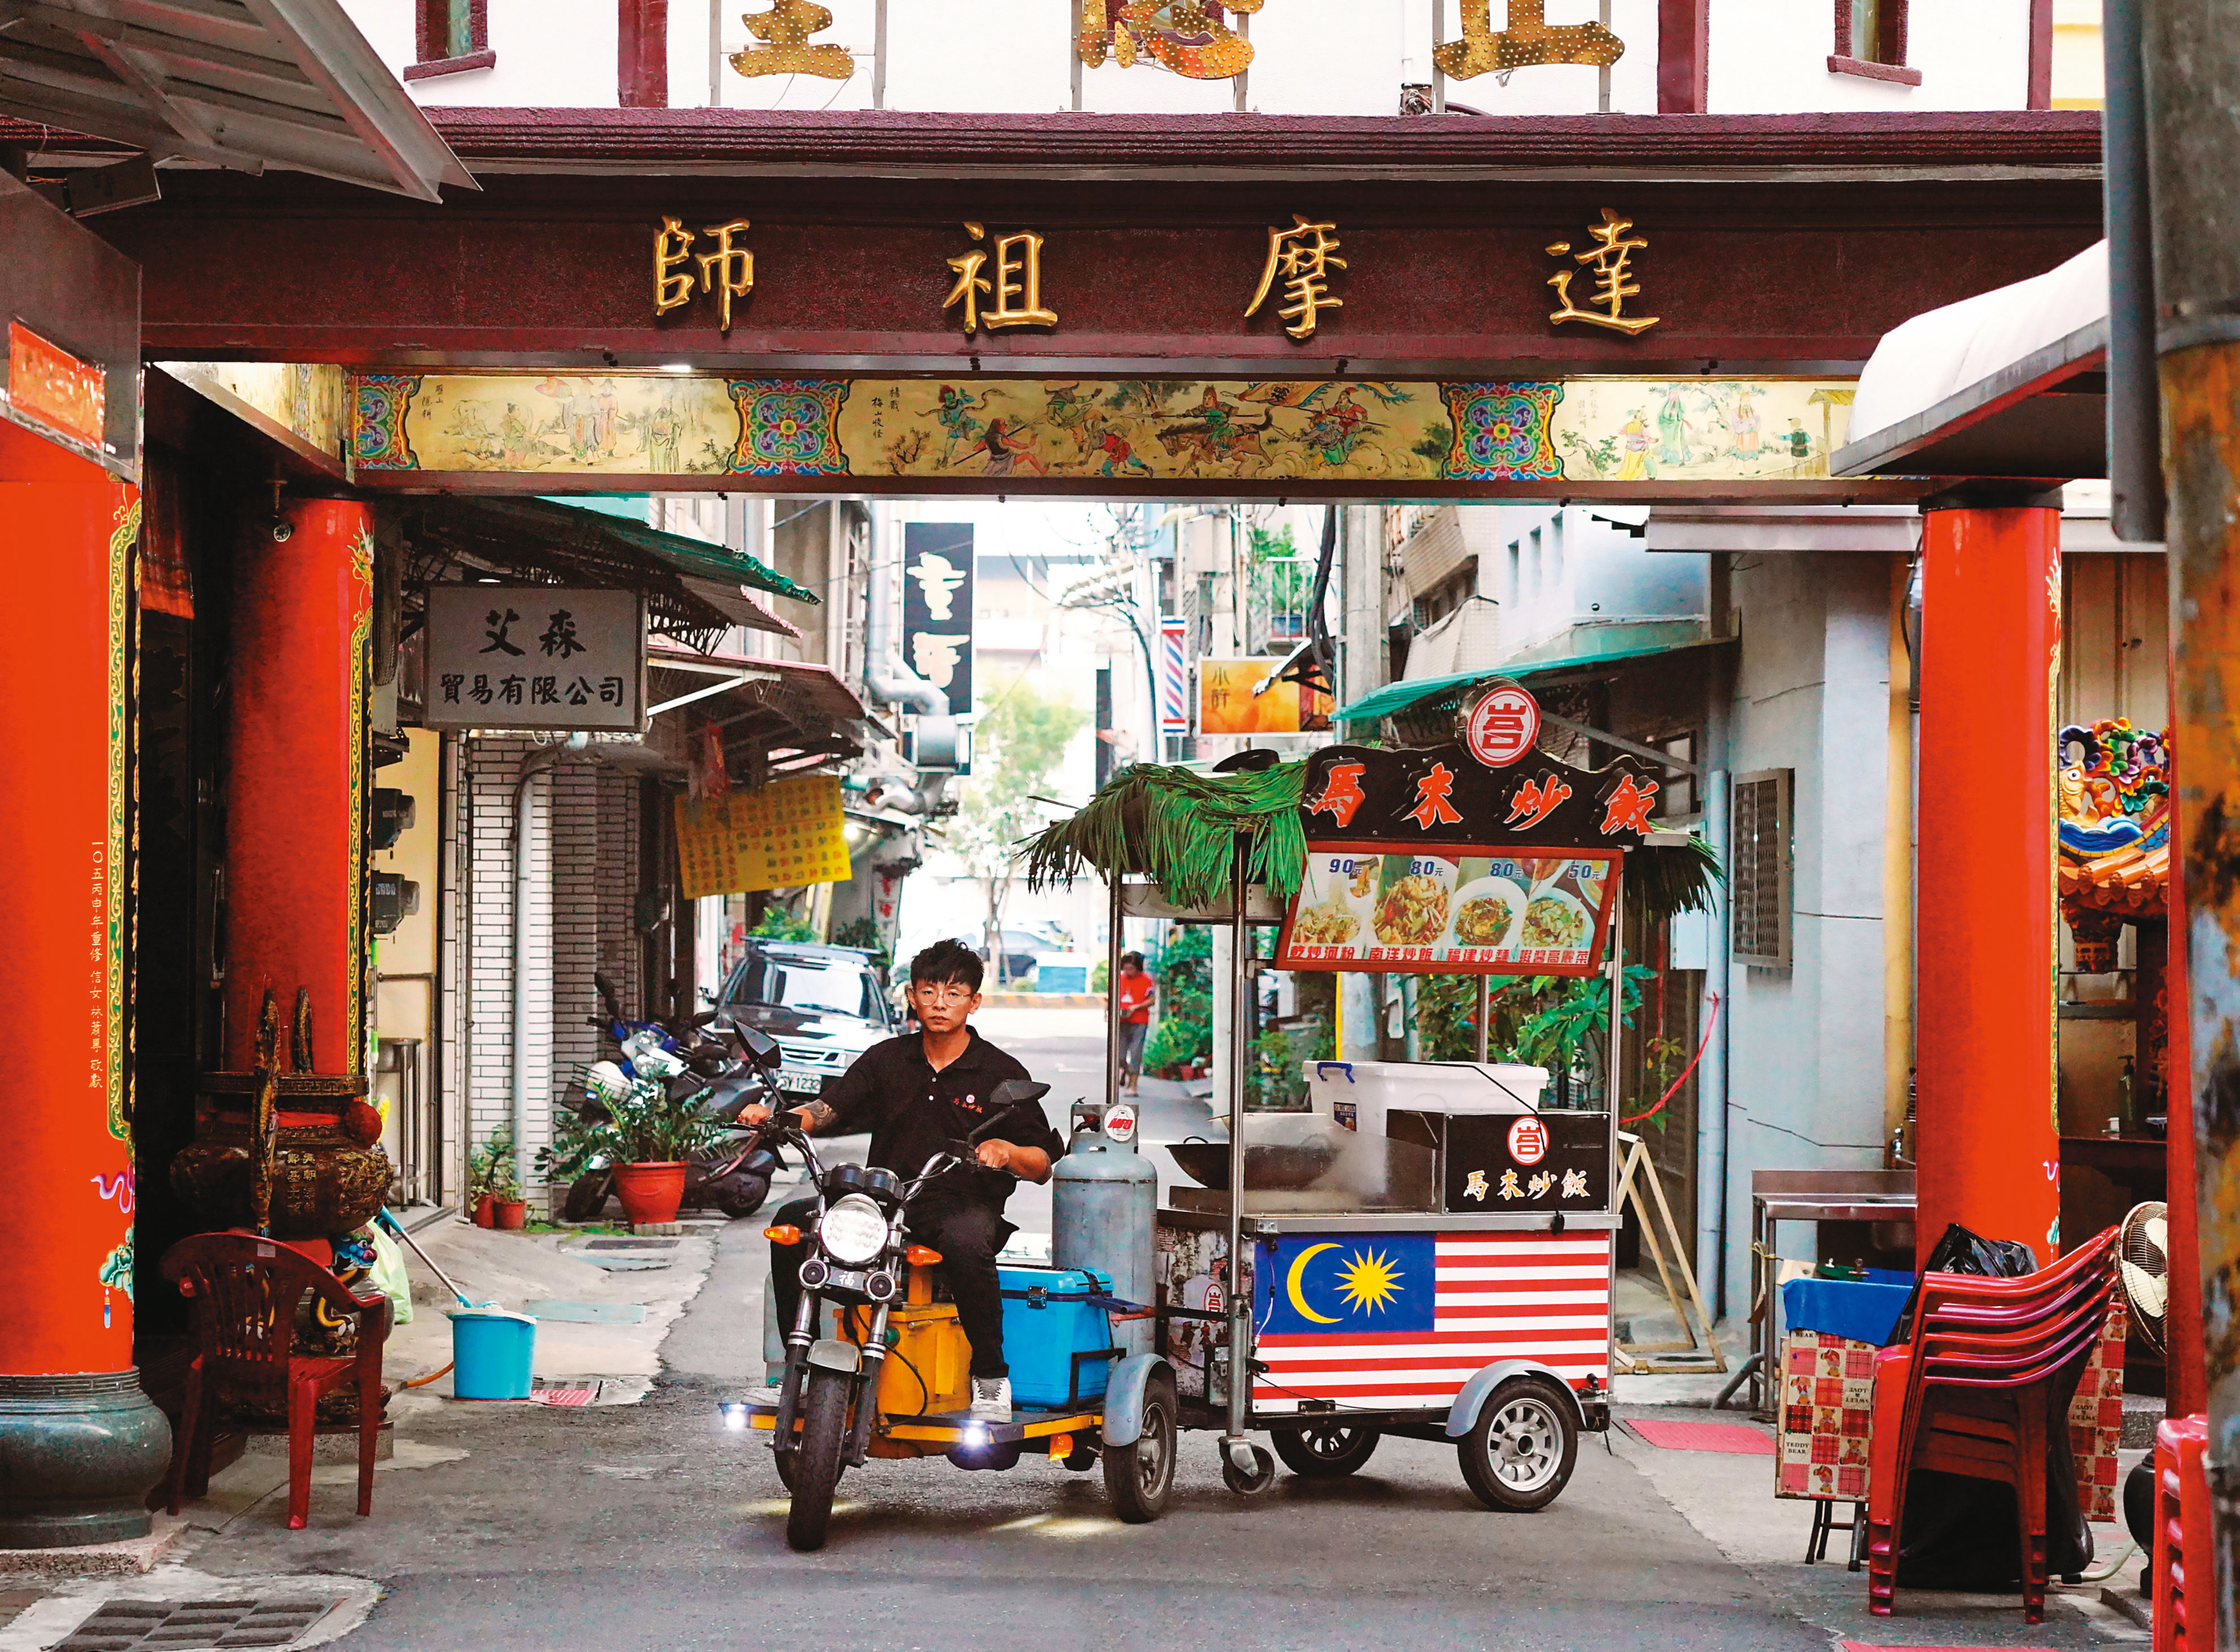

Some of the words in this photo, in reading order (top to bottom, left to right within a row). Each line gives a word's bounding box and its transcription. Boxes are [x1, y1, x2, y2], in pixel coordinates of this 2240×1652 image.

[479, 608, 586, 659] 艾森
[440, 674, 624, 707] 貿易有限公司
[1328, 858, 1362, 875] 90元
[1409, 861, 1443, 876] 80元
[1490, 862, 1523, 877] 80元
[1568, 864, 1601, 879] 50元
[1369, 947, 1433, 961] 南洋炒飯
[1519, 950, 1589, 964] 蝦醬高麗菜
[89, 970, 102, 999] 信女
[1463, 1168, 1590, 1201] 馬來炒飯
